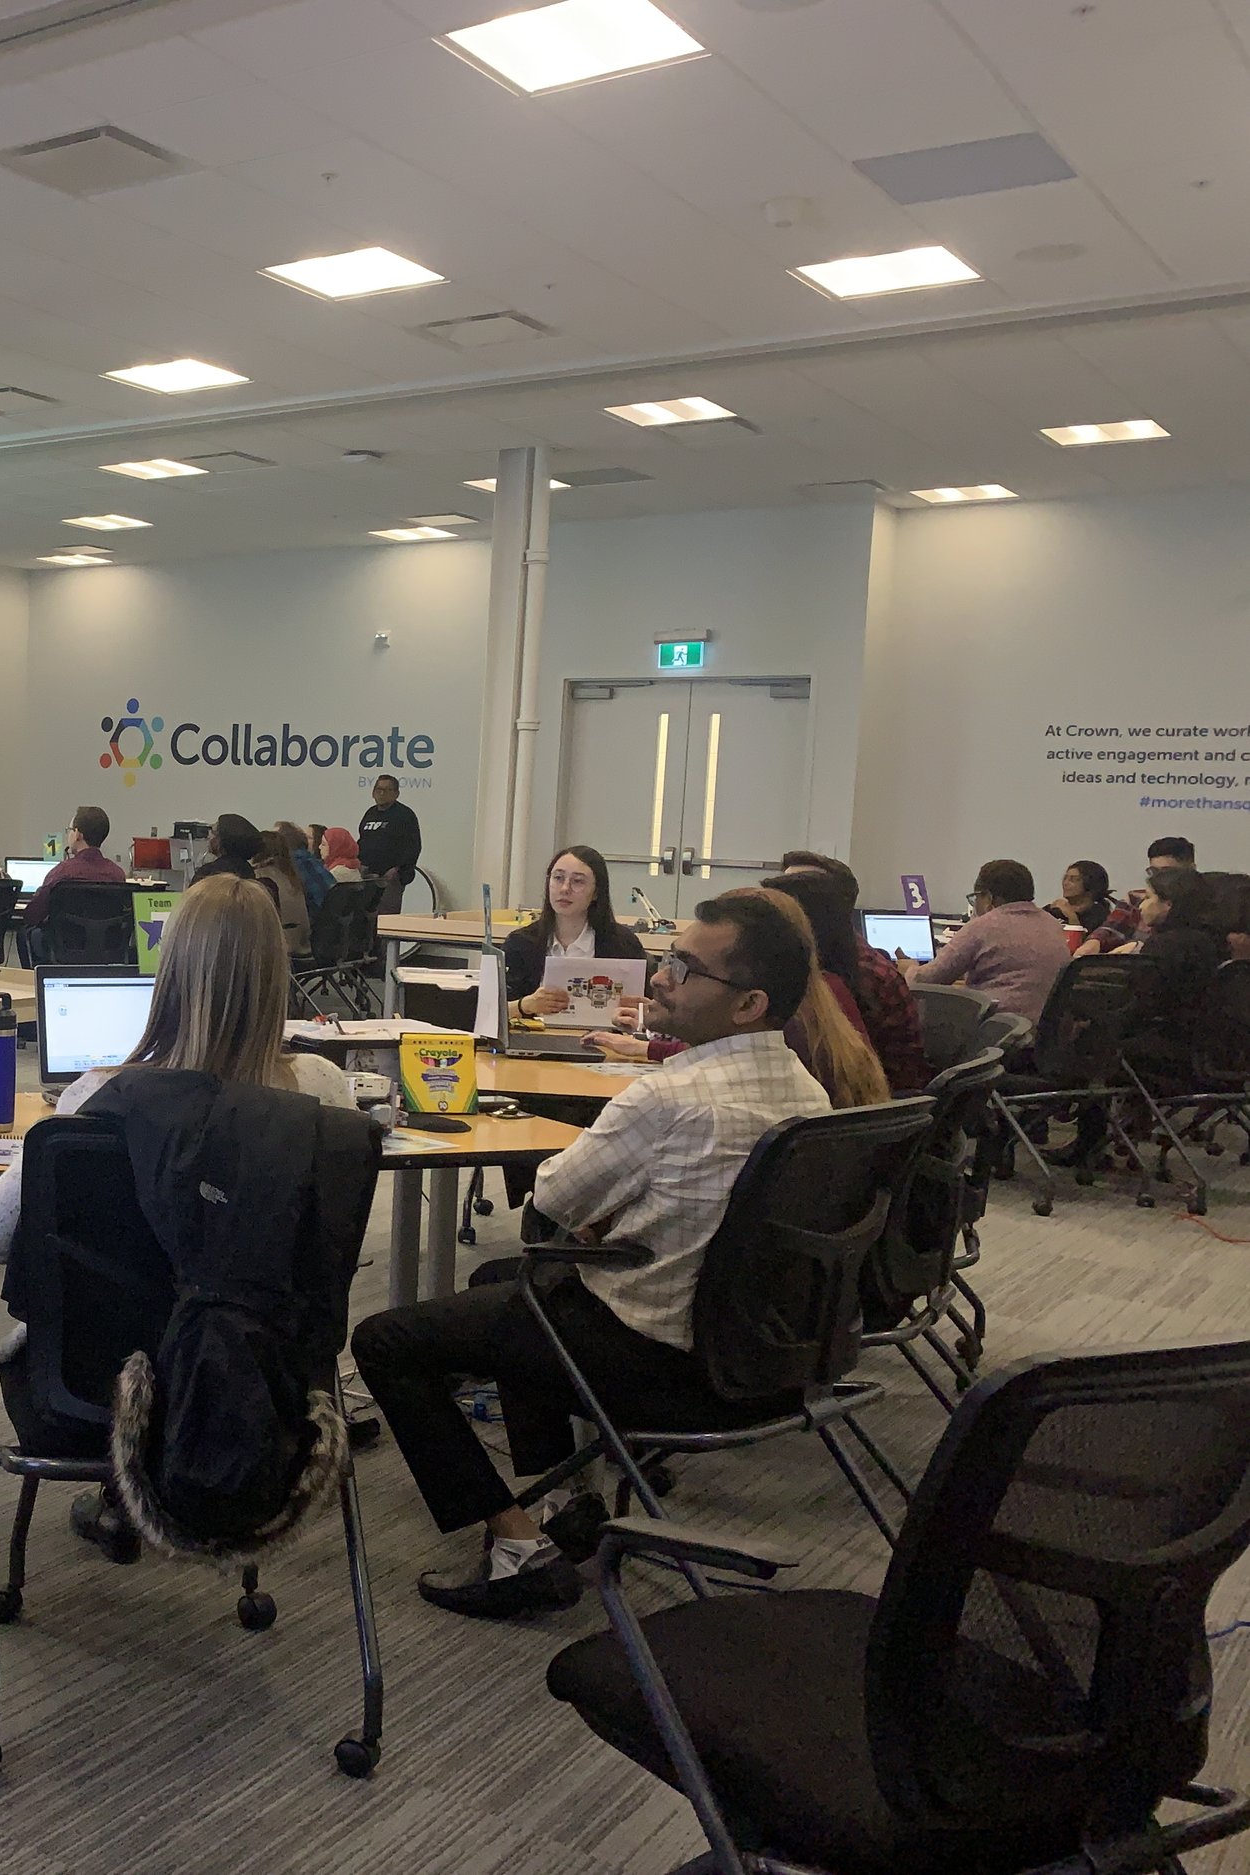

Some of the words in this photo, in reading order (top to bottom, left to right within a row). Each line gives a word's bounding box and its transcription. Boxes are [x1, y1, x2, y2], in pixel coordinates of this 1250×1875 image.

[1045, 725, 1062, 737] At
[1066, 725, 1123, 739] Crown,
[1128, 727, 1151, 737] we
[1155, 725, 1209, 737] curate
[1213, 725, 1250, 737] wor
[170, 723, 435, 768] Collaborate
[1046, 748, 1093, 760] active
[1097, 749, 1199, 763] engagement
[1204, 749, 1236, 762] and
[358, 776, 375, 788] BY
[1062, 771, 1102, 783] ideas
[1106, 772, 1136, 784] and
[1141, 772, 1239, 788] technology,
[47, 839, 56, 856] 1
[148, 898, 172, 908] Team
[908, 882, 923, 909] 3
[419, 1048, 458, 1058] Crayola
